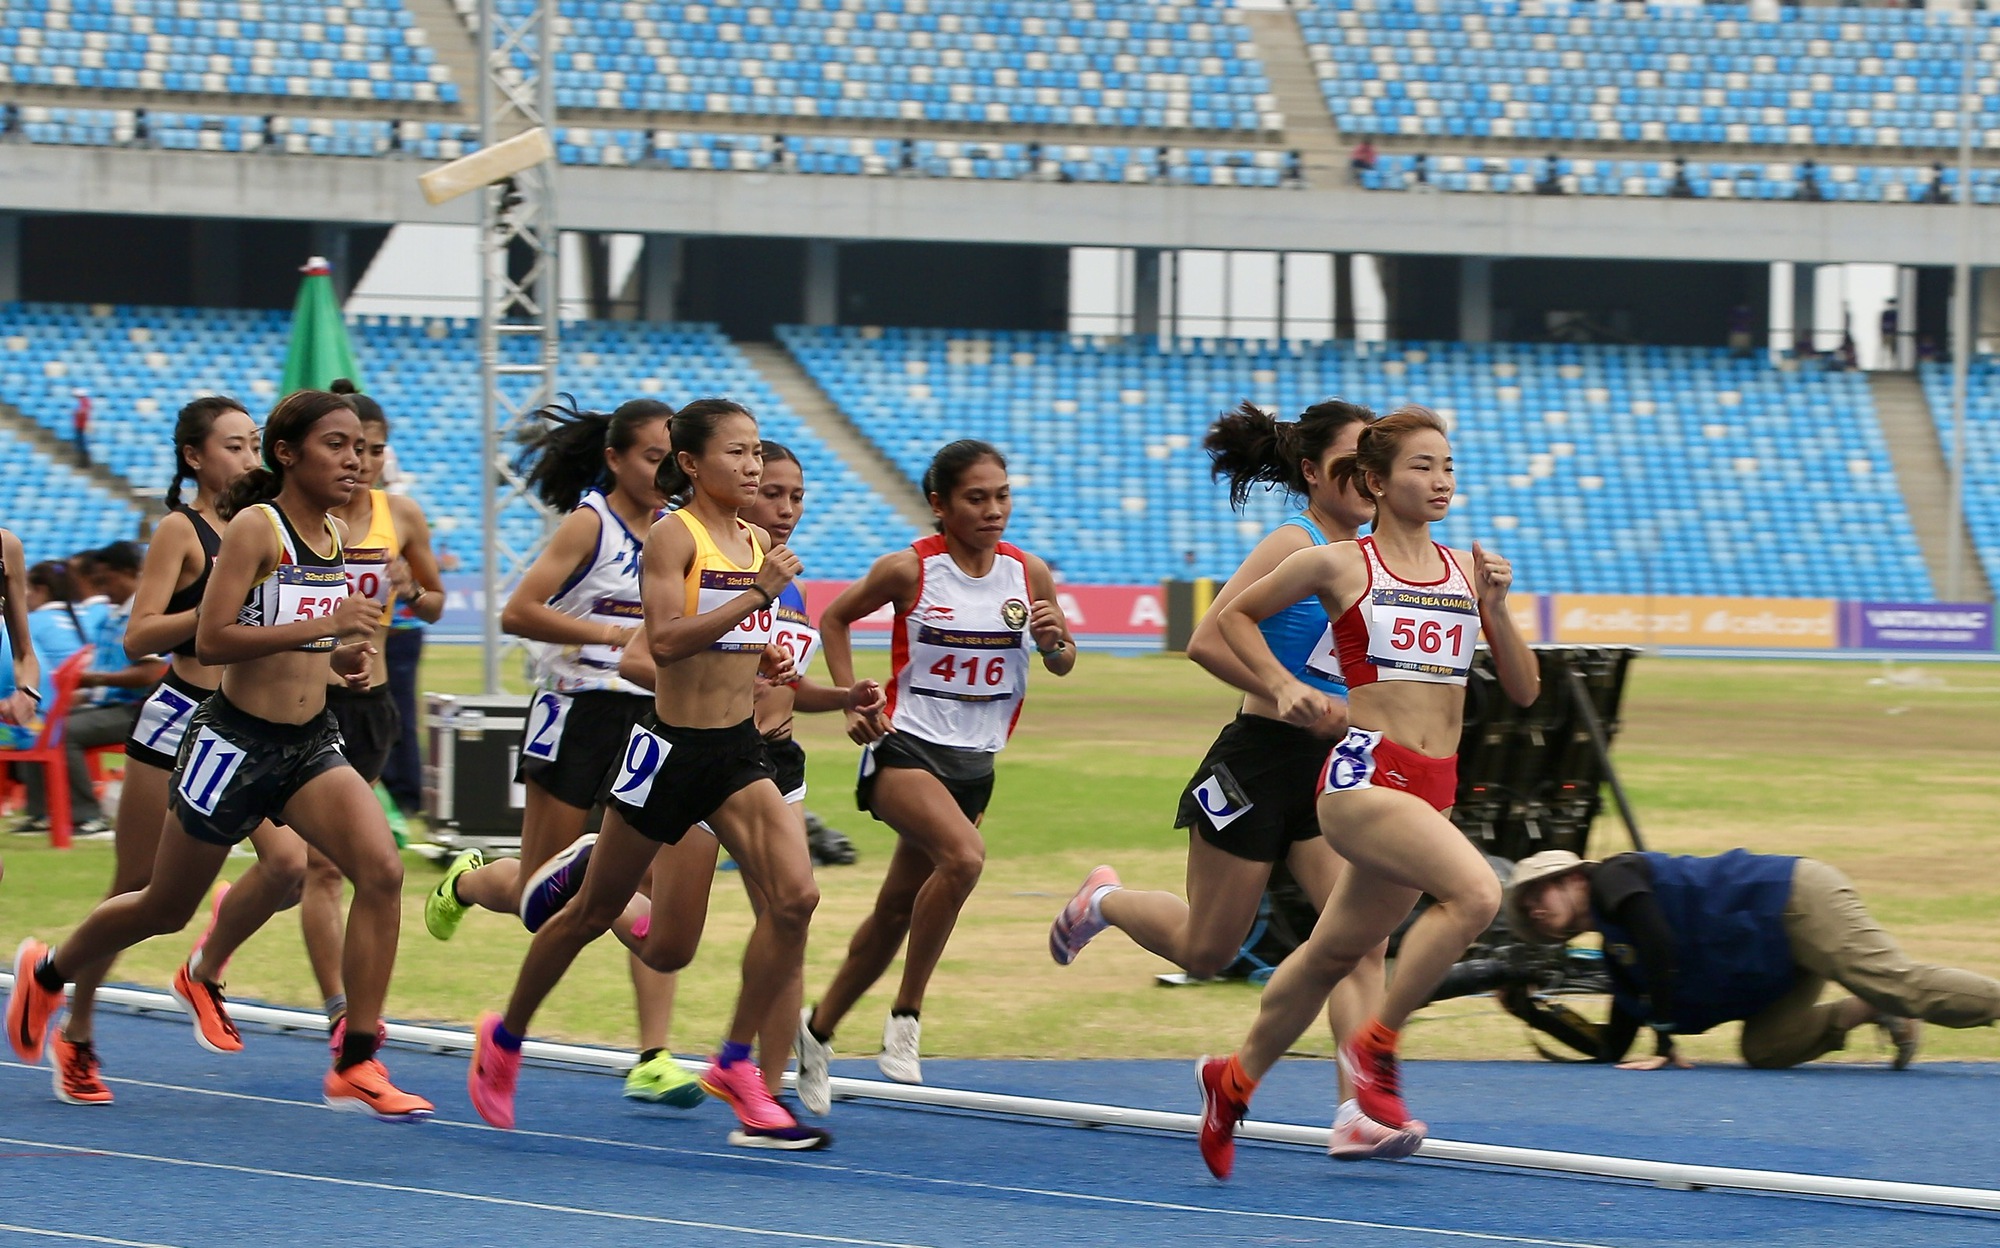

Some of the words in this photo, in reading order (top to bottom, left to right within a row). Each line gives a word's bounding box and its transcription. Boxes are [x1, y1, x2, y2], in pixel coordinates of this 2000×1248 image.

[726, 577, 742, 586] 32nd
[1398, 593, 1420, 604] 32nd
[1421, 595, 1440, 607] SEA
[1441, 598, 1472, 610] GAMES
[731, 607, 772, 632] 56
[1390, 617, 1463, 657] 561
[929, 654, 1006, 686] 416
[152, 689, 194, 747] 7
[526, 693, 561, 757] 2
[182, 739, 238, 811] 11
[613, 732, 660, 794] 9
[1330, 732, 1371, 789] 8
